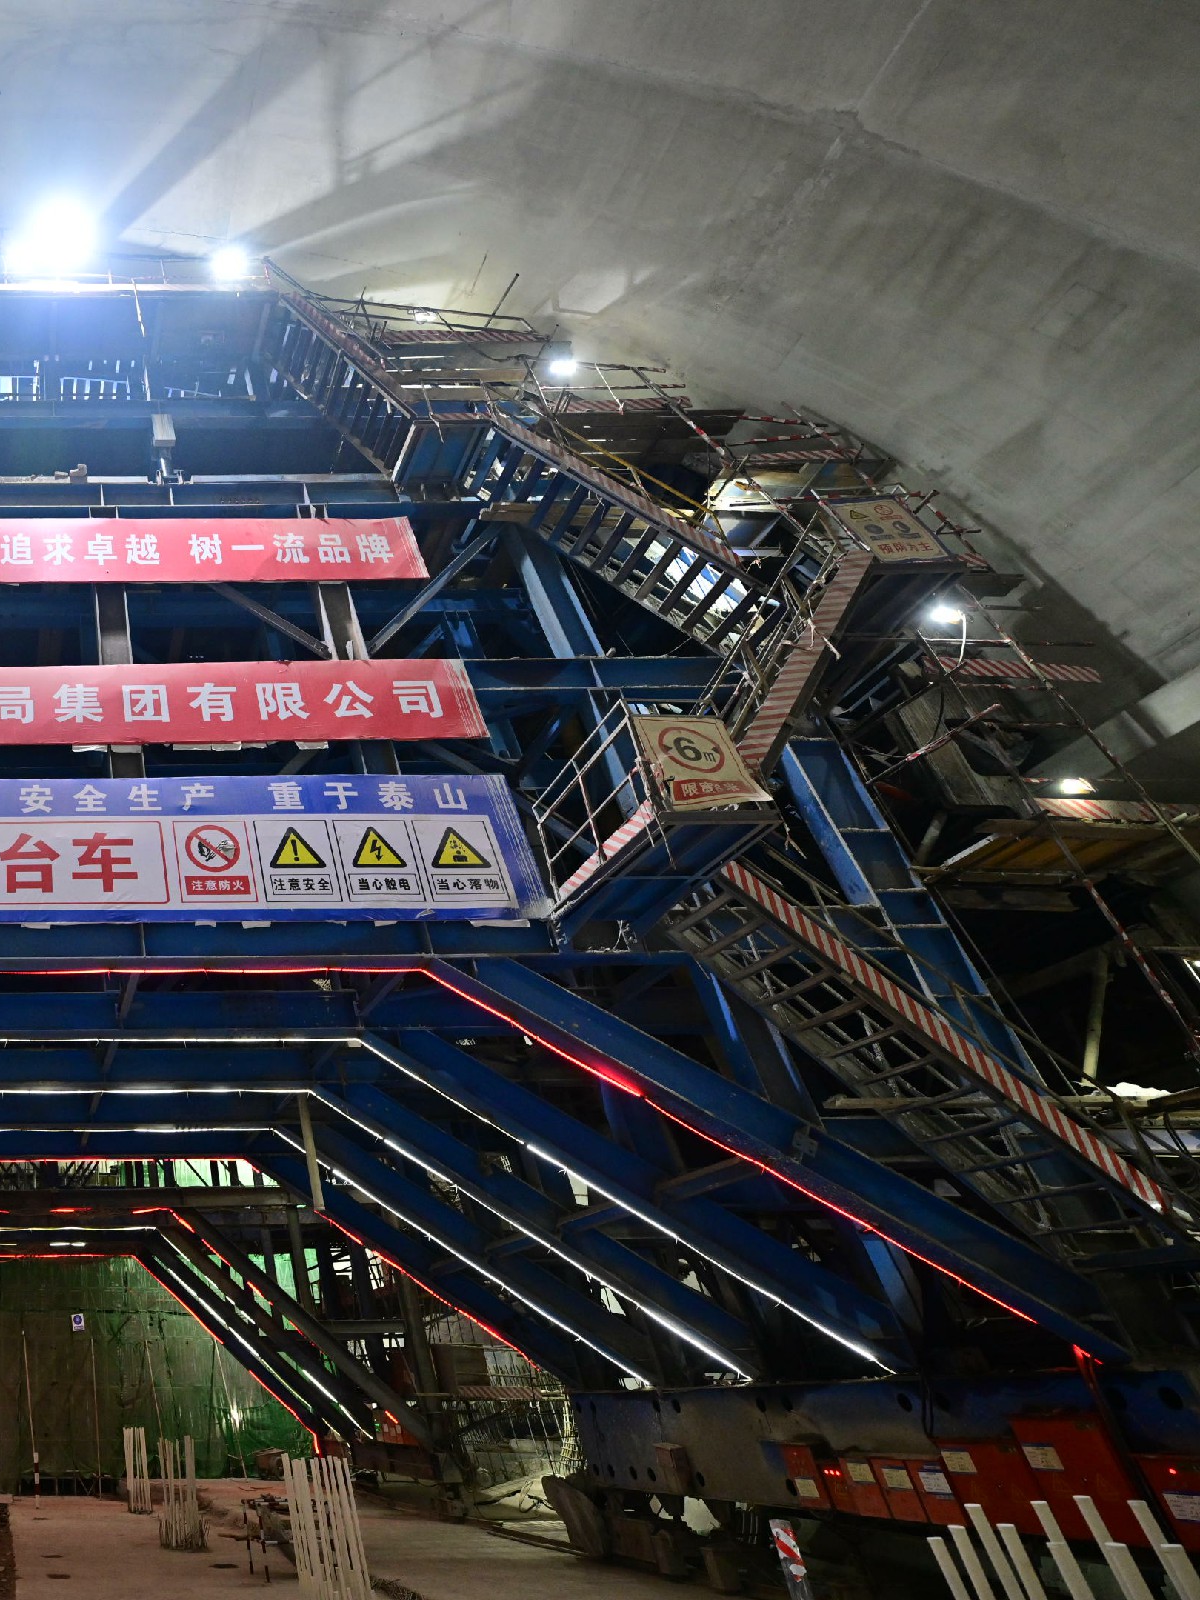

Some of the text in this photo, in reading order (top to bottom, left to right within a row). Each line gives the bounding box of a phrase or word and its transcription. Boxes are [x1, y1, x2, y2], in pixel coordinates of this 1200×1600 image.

[0, 532, 161, 565] 追求卓越
[188, 532, 396, 565] 树一流品牌
[19, 783, 216, 814] 安全生产
[268, 782, 469, 811] 重于泰山
[191, 879, 245, 892] 注意防火
[273, 878, 331, 892] 注意安全
[357, 878, 411, 892] 当心触电
[436, 878, 500, 891] 当心落物
